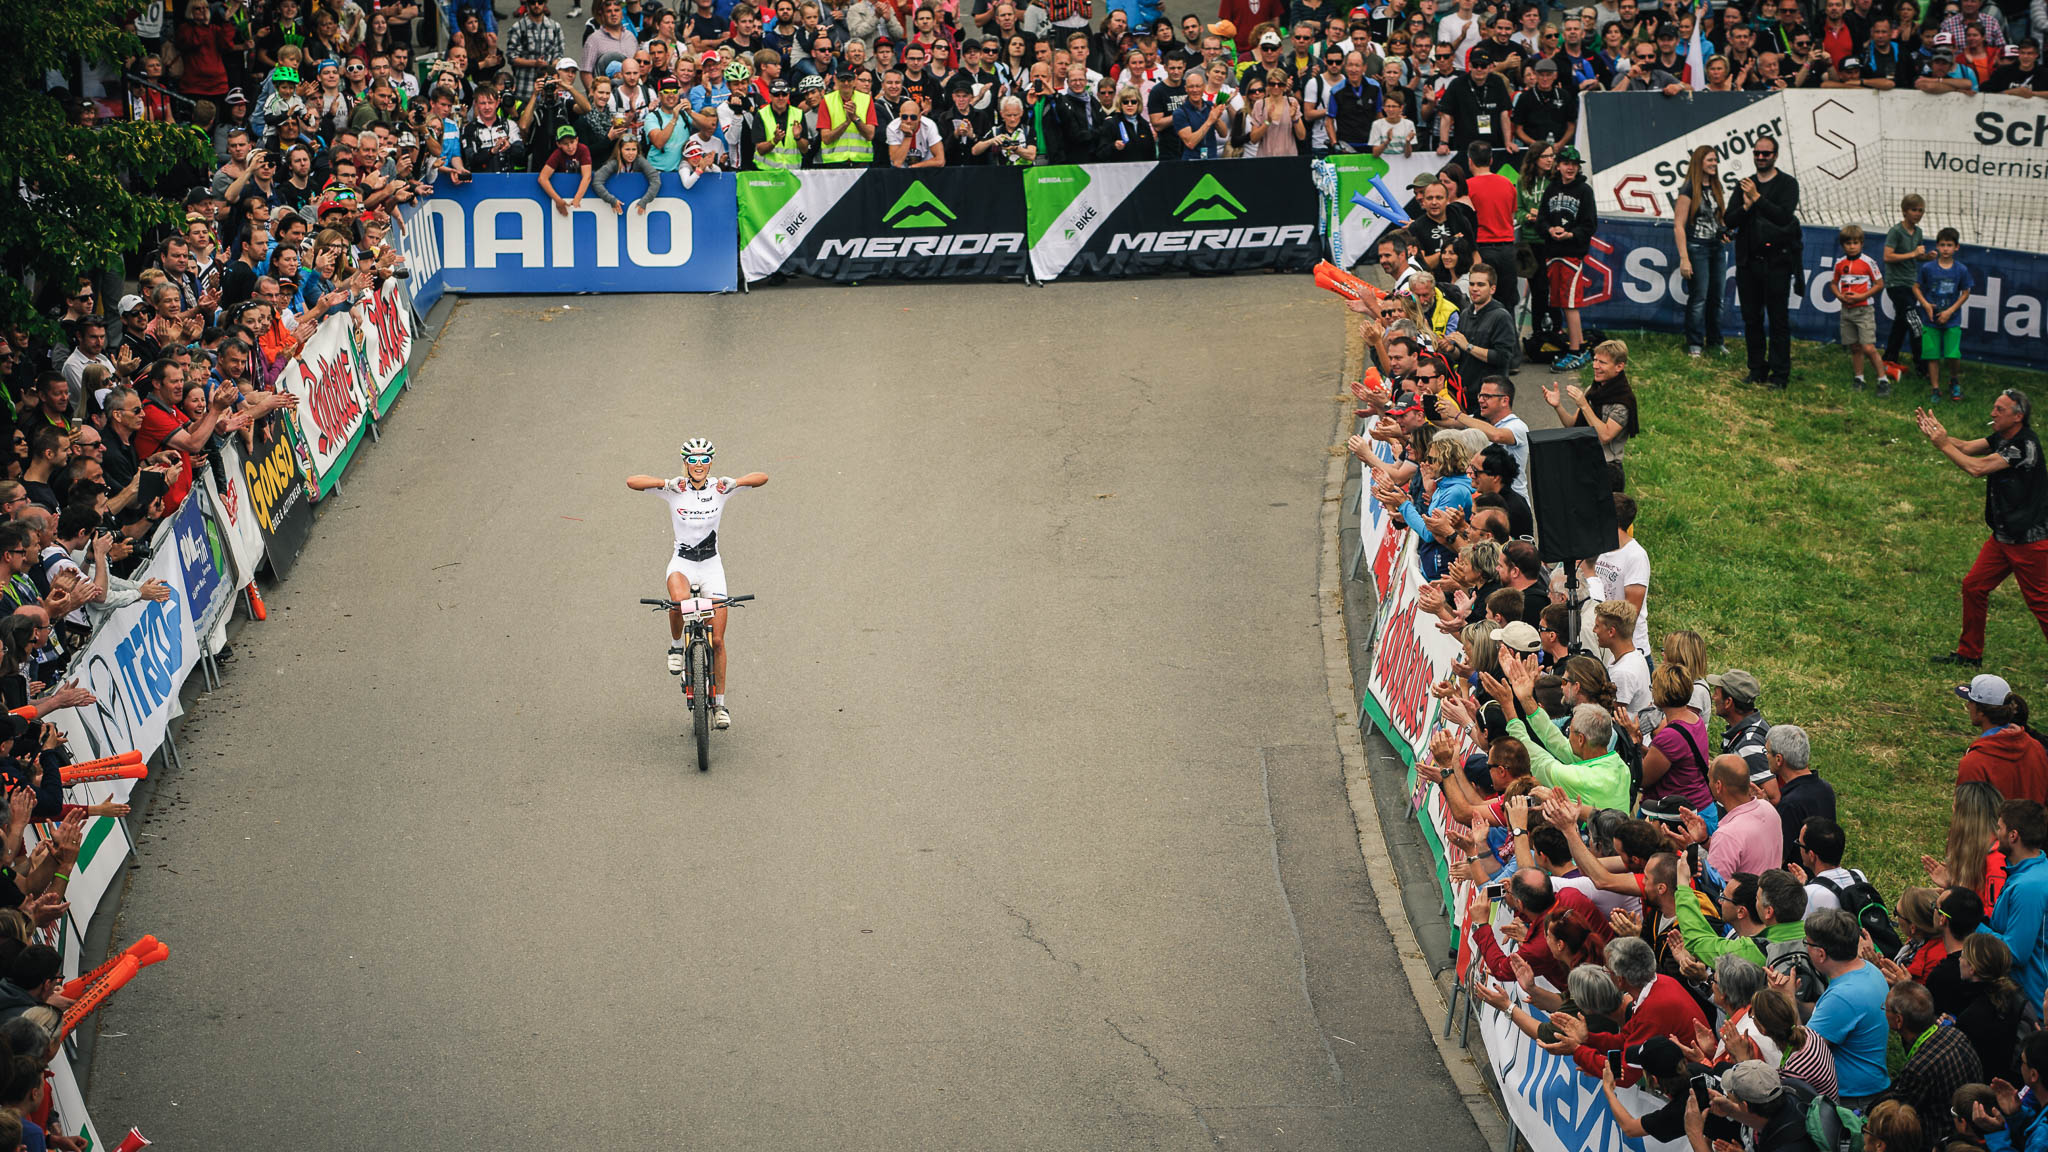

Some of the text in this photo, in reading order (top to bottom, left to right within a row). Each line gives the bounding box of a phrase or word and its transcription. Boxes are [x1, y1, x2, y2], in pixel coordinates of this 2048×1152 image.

[1655, 116, 1782, 187] Scwörer
[786, 212, 808, 236] BIKE
[1075, 206, 1097, 230] BIKE
[816, 233, 1025, 260] MERIDA
[1107, 225, 1314, 254] MERIDA
[694, 600, 699, 610] 1
